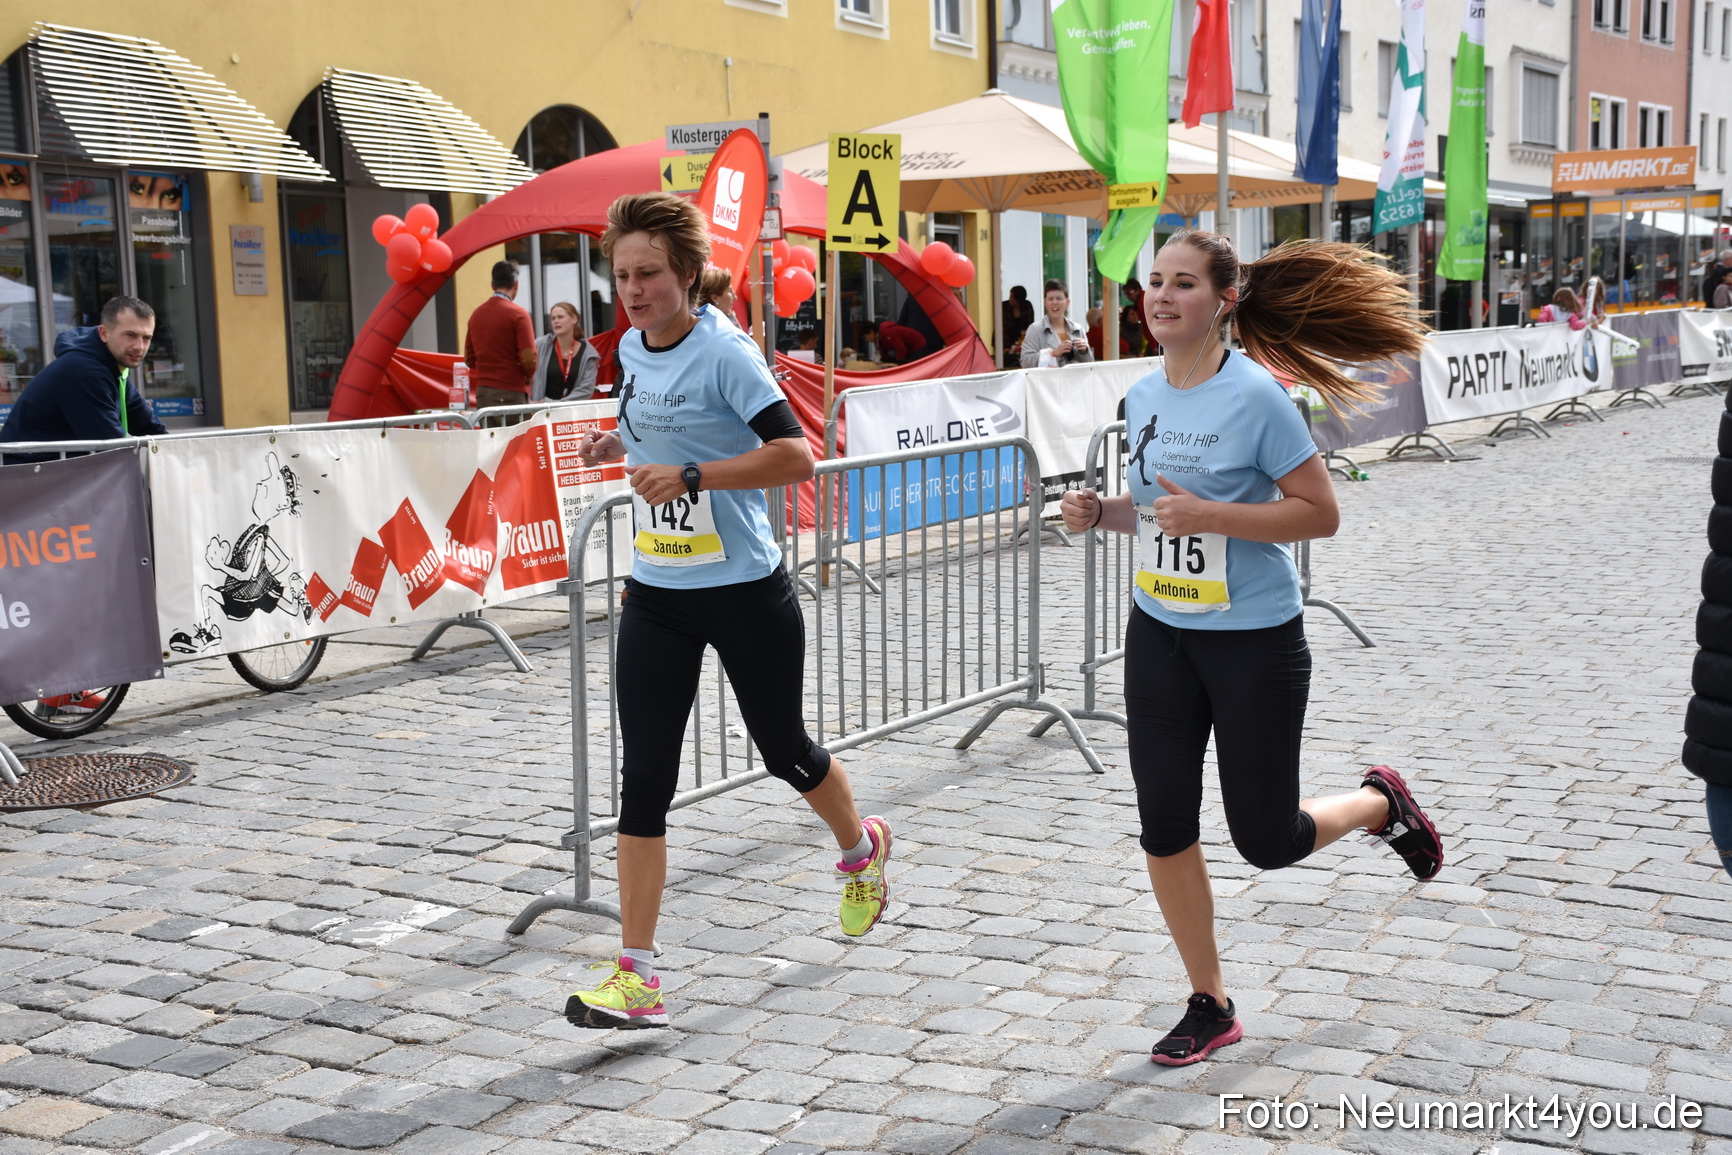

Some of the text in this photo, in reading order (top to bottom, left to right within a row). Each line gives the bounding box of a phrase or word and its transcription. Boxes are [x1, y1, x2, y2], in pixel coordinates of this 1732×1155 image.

[838, 137, 893, 160] Block
[688, 162, 709, 172] Dusc
[1557, 157, 1689, 182] RUNMARKT.DE
[842, 170, 883, 226] A
[142, 216, 178, 227] Passbilder
[715, 204, 738, 224] DKMS
[1447, 342, 1578, 399] PARTL Neumarkt
[638, 391, 686, 408] GYM HIP
[641, 411, 675, 423] P-Seminar
[897, 418, 988, 450] RAIL.ONE
[1161, 430, 1219, 448] GYM HIP
[536, 437, 547, 470] Seit 1929
[1162, 451, 1201, 463] P-Seminar
[1151, 461, 1210, 475] Halbmarathon
[563, 496, 581, 507] Braun
[650, 497, 694, 532] 142
[1140, 512, 1158, 525] PART
[0, 524, 97, 569] NGE
[445, 528, 493, 573] Braun
[500, 519, 559, 559] Braun
[654, 539, 692, 554] Sandra
[522, 552, 567, 568] Sicher ist siche
[1154, 531, 1205, 575] 115
[401, 548, 439, 596] Braun
[346, 574, 376, 603] Braun
[1153, 580, 1199, 600] Antonia
[313, 592, 335, 618] Braun
